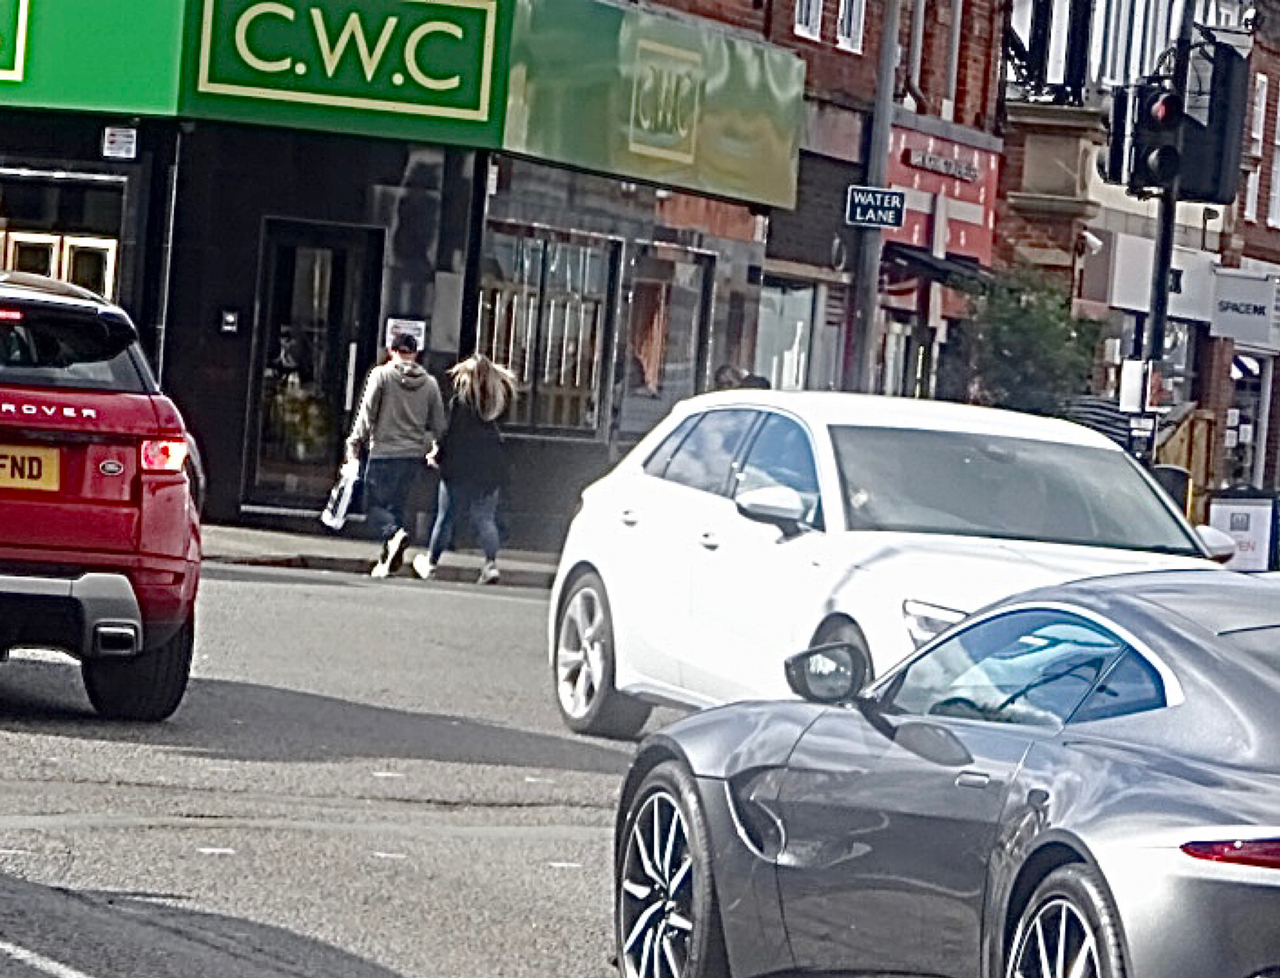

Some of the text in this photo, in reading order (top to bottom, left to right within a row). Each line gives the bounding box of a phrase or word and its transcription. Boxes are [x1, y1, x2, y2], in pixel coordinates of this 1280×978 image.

[235, 2, 463, 91] C.W.C
[853, 191, 901, 208] WATER
[856, 206, 896, 223] LANE
[1, 403, 96, 418] ROVER
